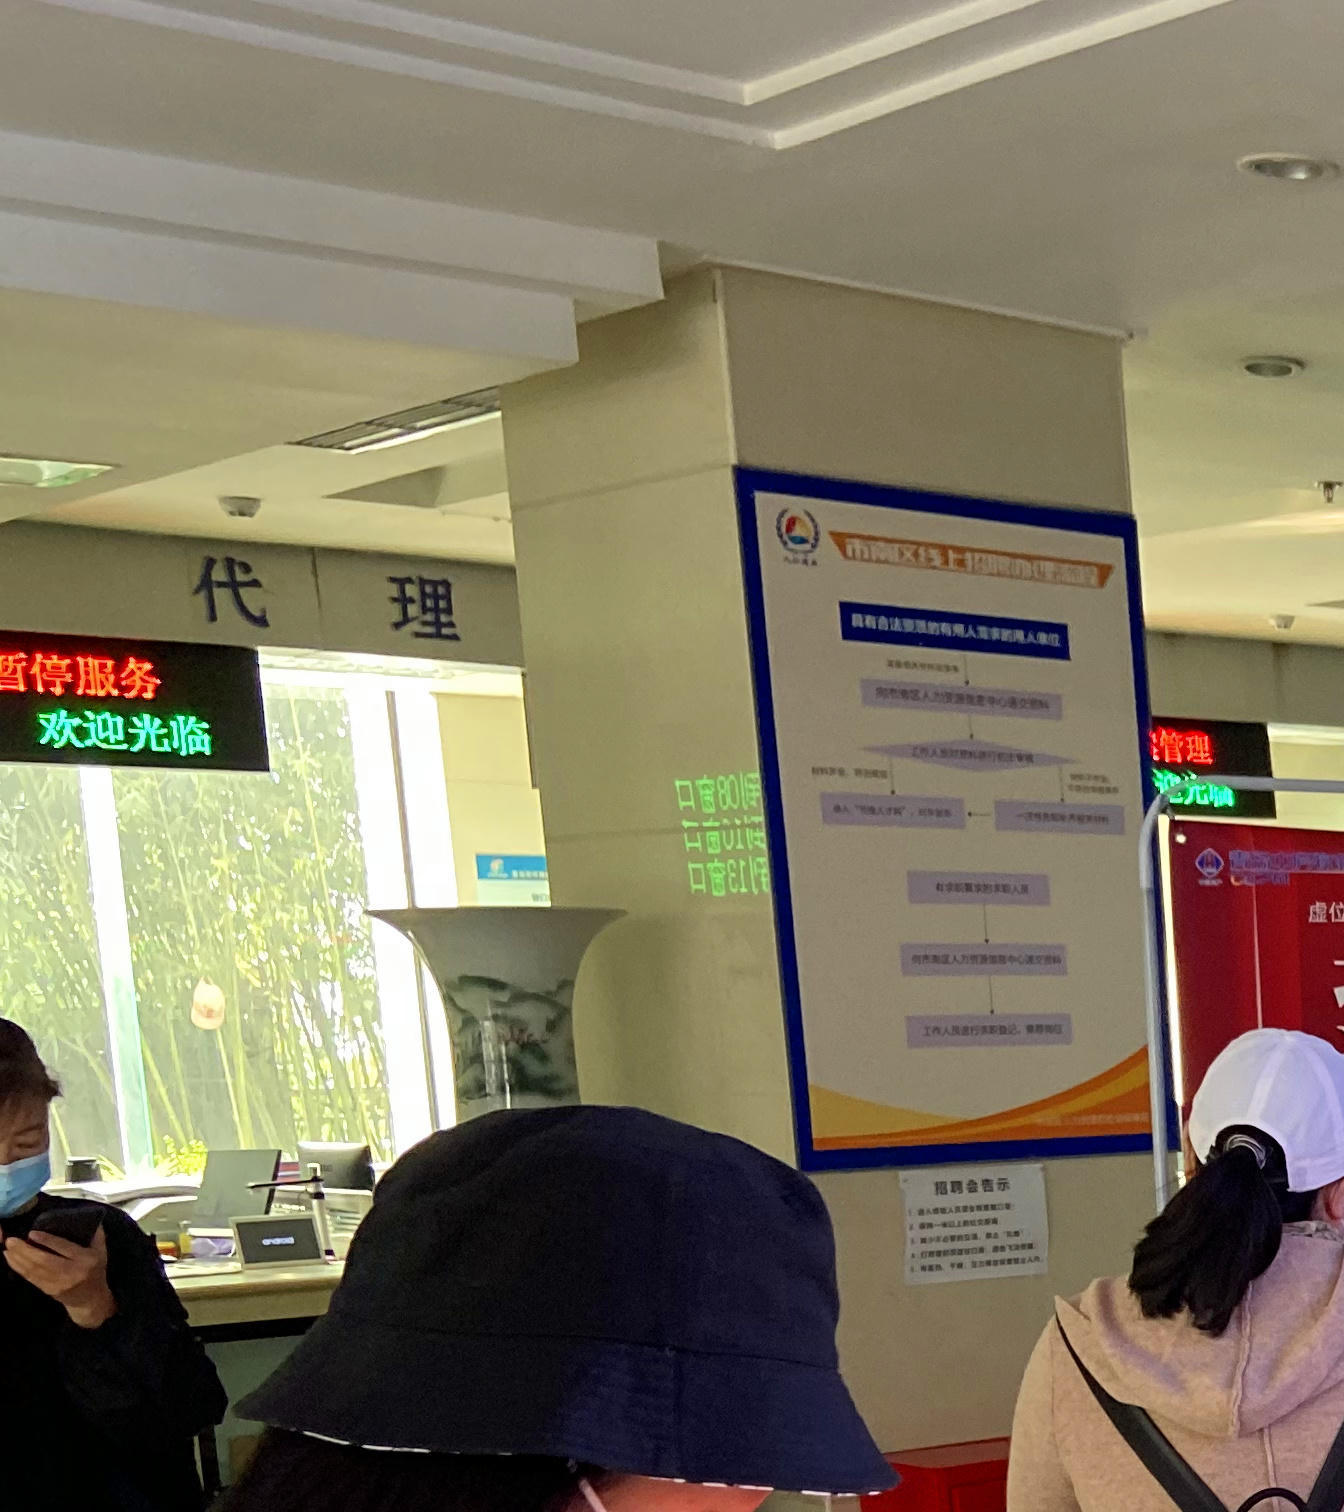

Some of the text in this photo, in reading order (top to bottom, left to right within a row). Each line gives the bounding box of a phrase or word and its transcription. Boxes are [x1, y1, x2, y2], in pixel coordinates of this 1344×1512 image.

[190, 556, 462, 643] 代理
[0, 652, 162, 699] 暂停服务
[37, 708, 212, 757] 欢迎光临
[934, 1178, 1011, 1196] 招聘会告示
